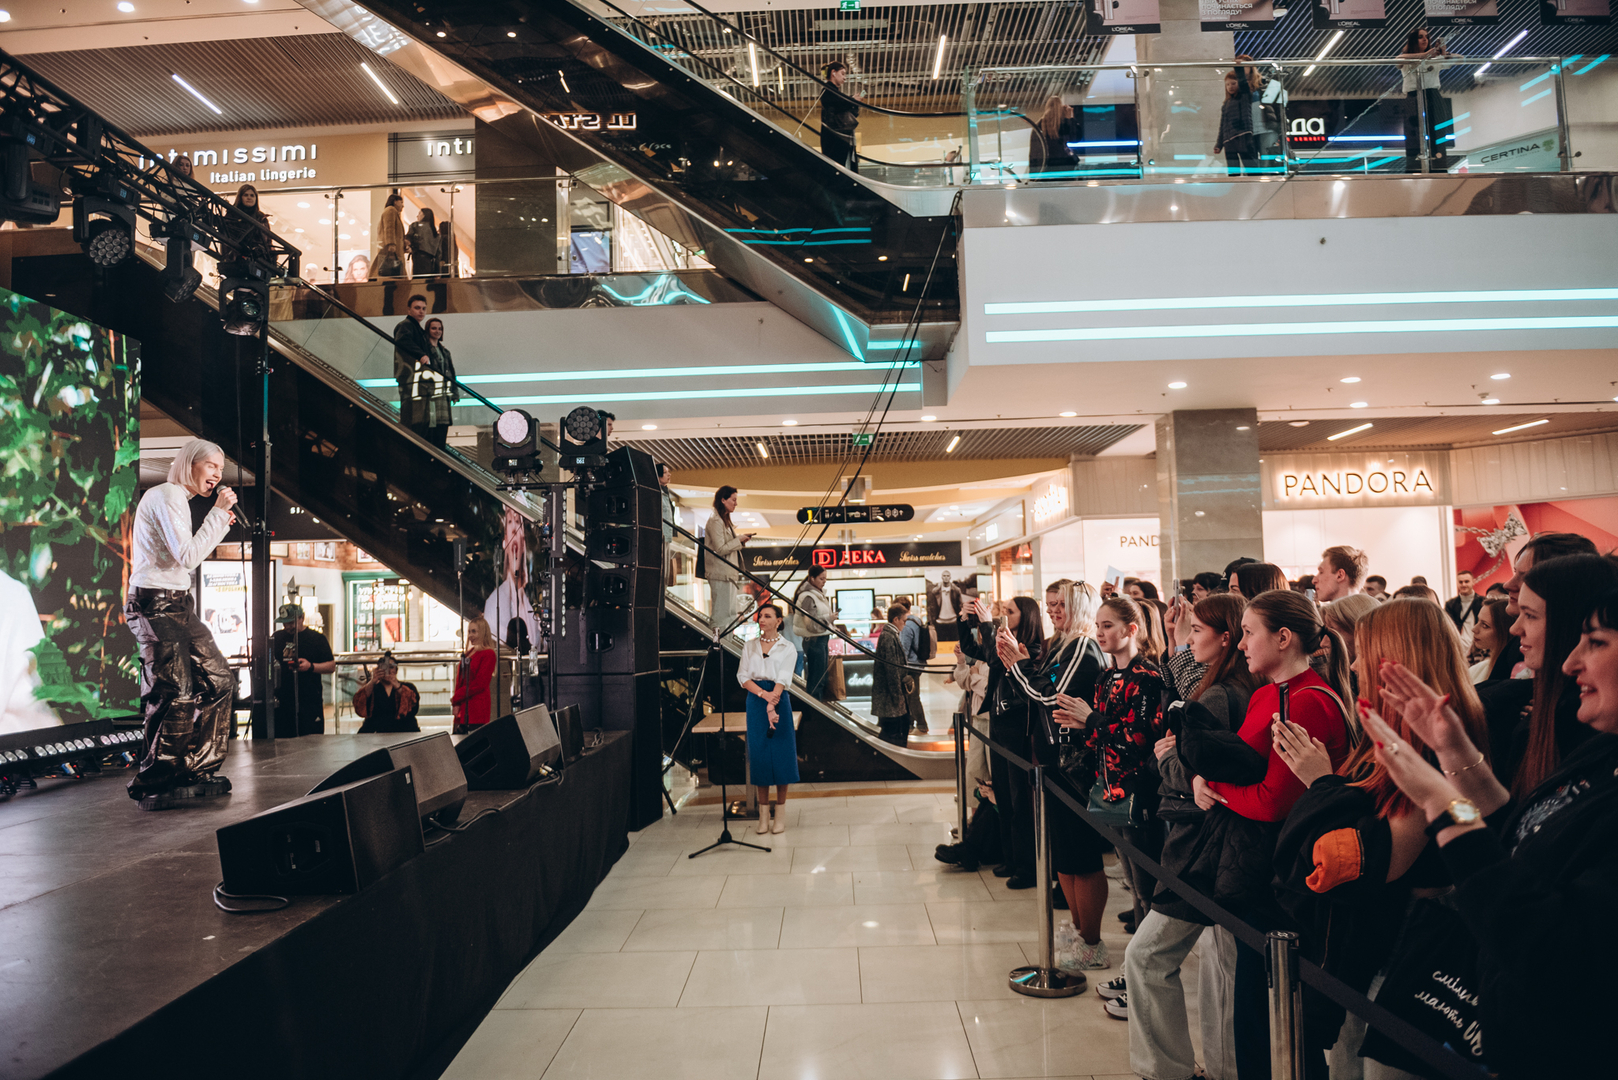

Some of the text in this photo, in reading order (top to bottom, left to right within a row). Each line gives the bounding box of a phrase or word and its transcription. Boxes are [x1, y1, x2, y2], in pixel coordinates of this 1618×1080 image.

[1480, 143, 1541, 164] CERTINA
[210, 167, 317, 184] Italian lingerie
[1284, 470, 1434, 497] PANDORA
[1120, 535, 1160, 548] PAND
[752, 555, 800, 567] Swiss watches
[838, 549, 887, 567] ДЕКА
[899, 551, 946, 562] Swiss watches
